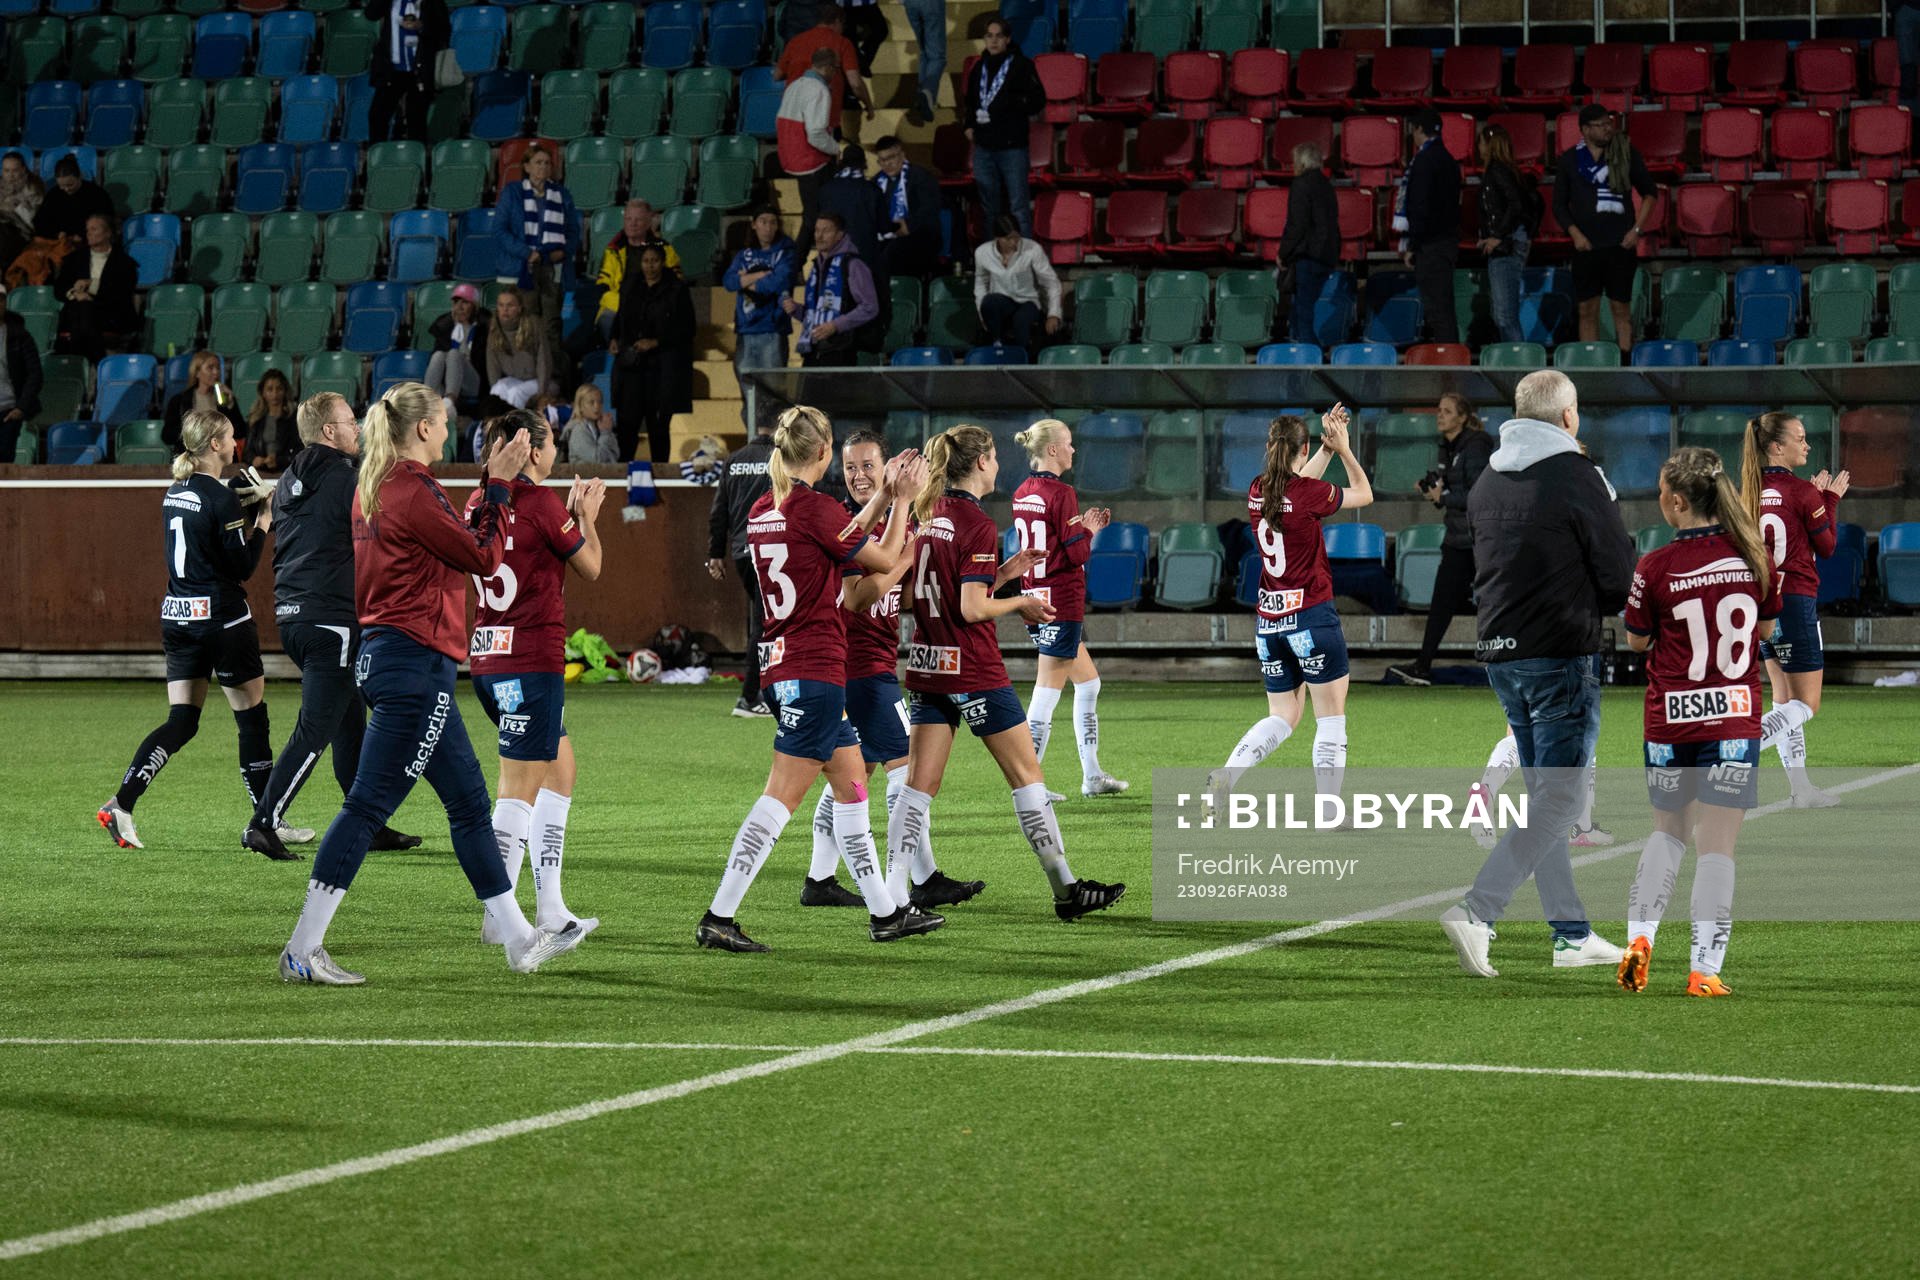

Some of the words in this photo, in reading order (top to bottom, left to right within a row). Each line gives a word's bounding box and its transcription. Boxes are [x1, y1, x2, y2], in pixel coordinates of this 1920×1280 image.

[729, 462, 769, 476] SERNEK
[170, 516, 187, 578] 1
[1257, 518, 1287, 578] 9
[749, 543, 797, 620] 13
[914, 543, 941, 618] 4
[907, 647, 938, 671] ESAB
[1672, 593, 1758, 681] 18
[1668, 691, 1728, 720] BESAB
[404, 691, 450, 779] factoring
[1083, 712, 1097, 746] MIKE
[136, 745, 169, 785] MIKE
[1317, 741, 1337, 777] MIKE
[1648, 767, 1682, 789] NTEX
[1707, 761, 1752, 783] NTEX
[1714, 785, 1740, 795] umbro
[540, 823, 565, 868] MIKE
[731, 821, 771, 876] MIKE
[900, 805, 924, 856] MIKE
[843, 833, 875, 879] MIKE
[1711, 904, 1732, 950] MIKE
